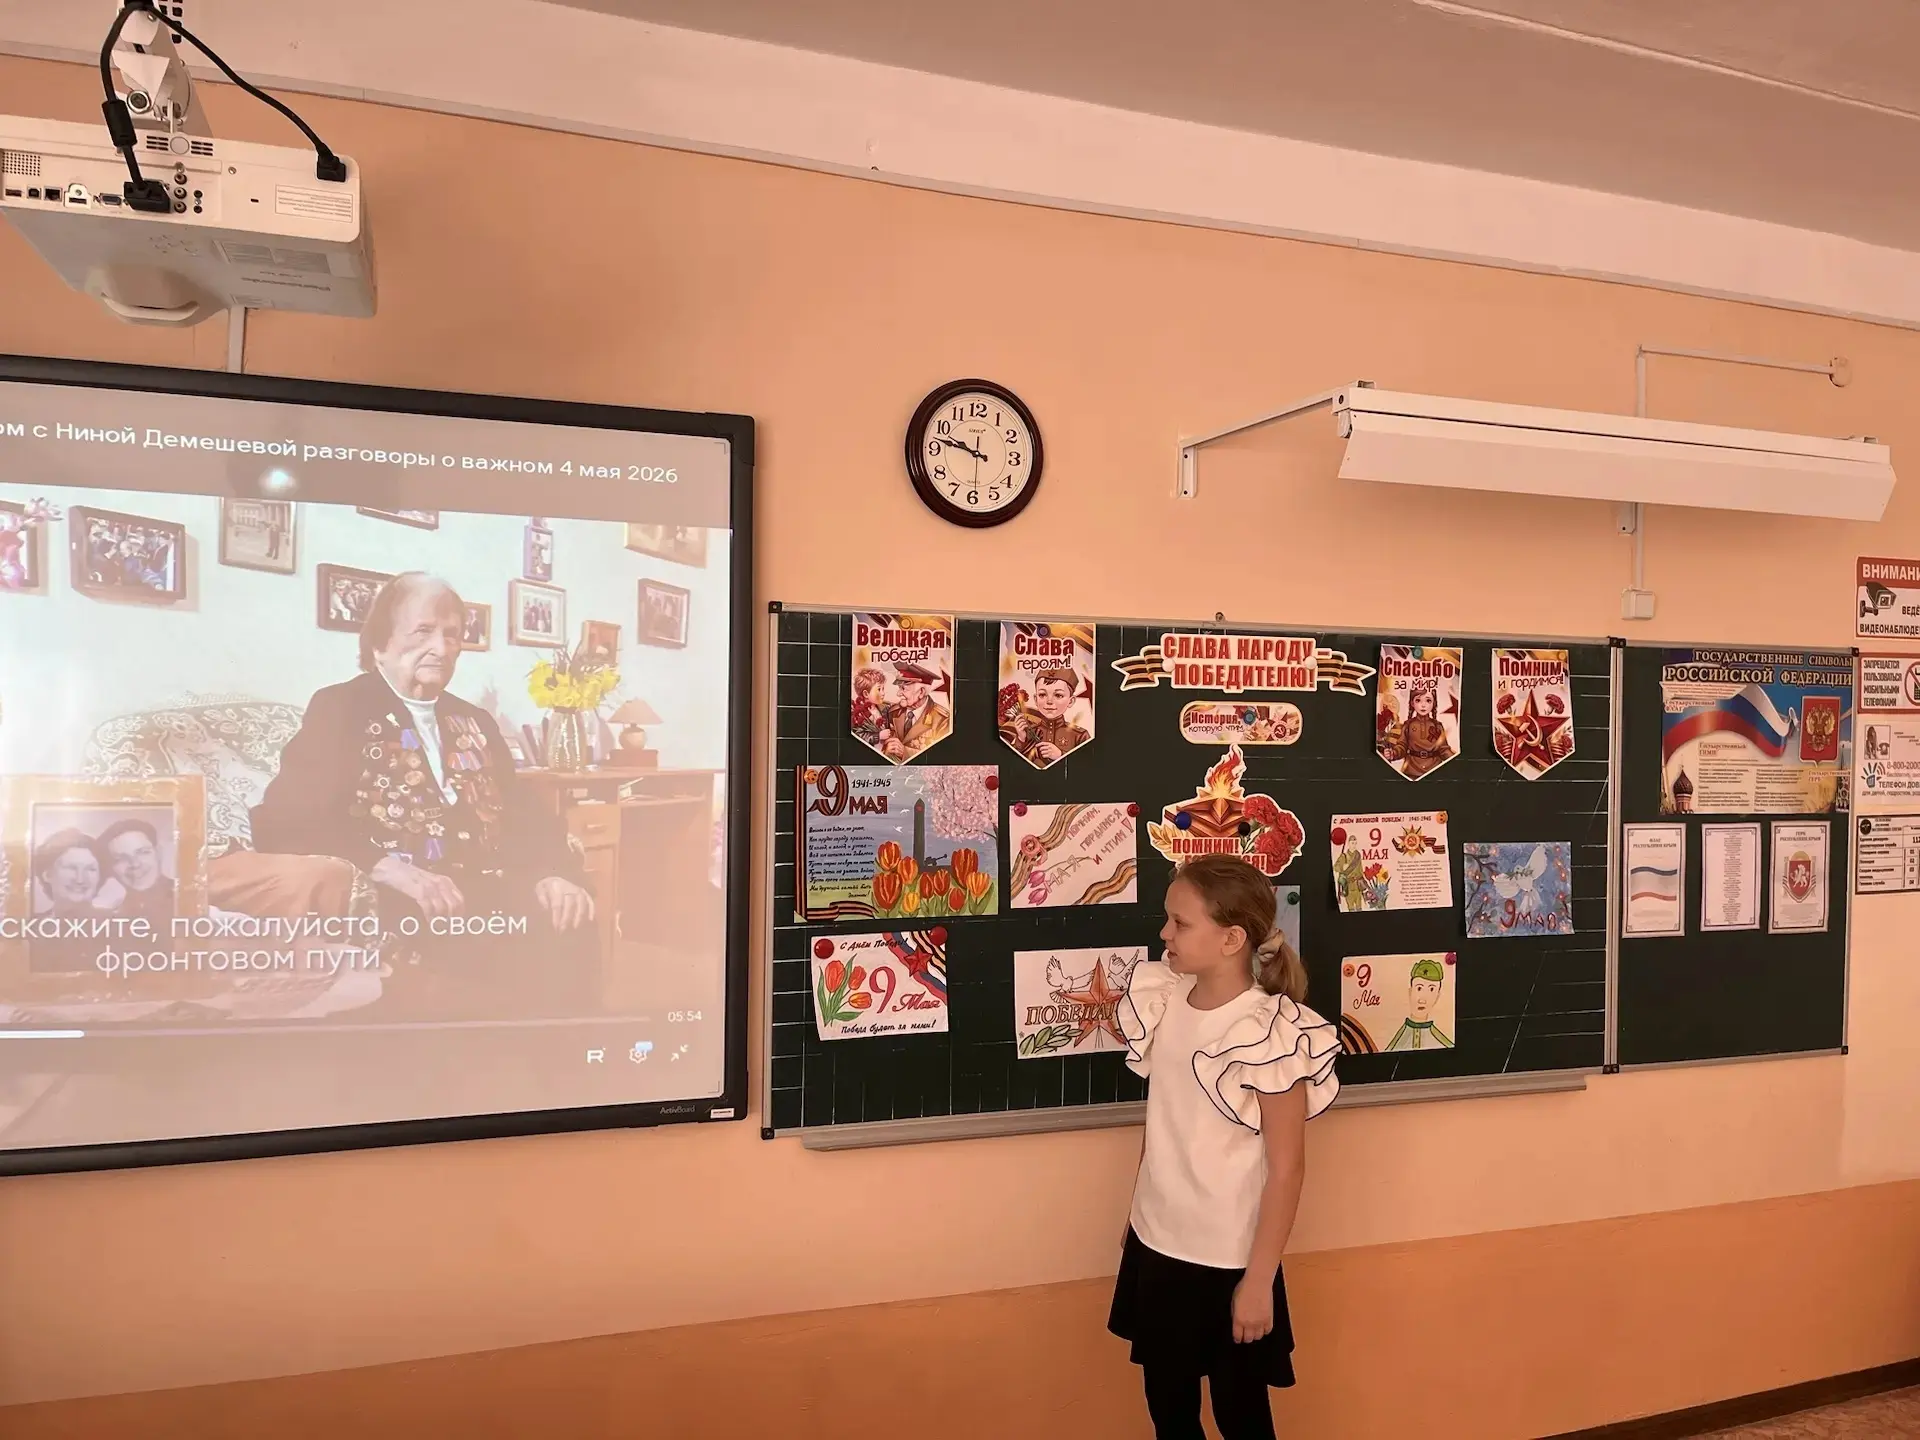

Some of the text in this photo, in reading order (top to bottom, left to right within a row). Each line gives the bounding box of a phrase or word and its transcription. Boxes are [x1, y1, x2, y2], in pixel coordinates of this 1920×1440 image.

[952, 406, 964, 421] 11
[969, 402, 988, 418] 12
[937, 420, 951, 435] 10
[995, 412, 1001, 427] 1
[1005, 429, 1017, 444] 2
[33, 425, 48, 438] с
[56, 421, 136, 445] Ниной
[143, 429, 297, 457] Демешевой
[303, 444, 435, 469] разговоры
[441, 455, 456, 468] о
[461, 456, 552, 474] важном
[559, 460, 574, 476] 4
[579, 464, 621, 480] мая
[628, 465, 679, 484] 2026
[928, 441, 941, 456] 9
[1008, 451, 1021, 466] 3
[934, 465, 946, 480] 8
[948, 482, 960, 496] 7
[1000, 474, 1013, 489] 4
[966, 490, 979, 505] 6
[988, 486, 1000, 501] 5
[857, 624, 945, 648] Великая
[1015, 633, 1074, 656] Слава
[1163, 636, 1232, 660] СЛАВА
[871, 647, 929, 663] победа!
[1694, 650, 1852, 667] ГОСУДАРСТВЕННЫЕ СИМВОЛЫ
[1017, 655, 1071, 674] героям!
[1384, 656, 1454, 679] Спасибо
[1499, 657, 1562, 676] Помним
[1863, 660, 1899, 669] ЗАПРЕЩАЕТСЯ
[1174, 663, 1316, 690] ПОБЕДИТЕЛЮ!
[1394, 677, 1439, 692] за мир!
[1498, 673, 1564, 691] и гордимся!
[1666, 666, 1852, 687] РОССИЙСКОЙ ФЕДЕРАЦИИ
[1863, 672, 1902, 682] ПОЛЬЗОВАТЬСЯ
[1863, 685, 1899, 694] МОБИЛЬНЫМИ
[1863, 697, 1897, 706] ТЕЛЕФОНАМИ
[1191, 711, 1242, 726] История,
[1188, 724, 1245, 734] которую чтим
[1699, 742, 1747, 750] Государственный
[807, 765, 891, 816] 9 1941-1945
[849, 795, 888, 815] МАЯ
[1066, 807, 1101, 841] ПОМНИМ,
[1080, 808, 1123, 852] ГОРДИМСЯ
[1369, 828, 1382, 847] 9
[1172, 838, 1240, 854] ПОМНИМ!
[1362, 848, 1389, 860] МАЯ
[1092, 854, 1103, 866] И
[1500, 899, 1516, 928] 9
[0, 911, 528, 944] скажите, пожалуйста, о своём
[840, 942, 847, 950] С
[847, 942, 871, 951] Днём
[96, 945, 381, 979] фронтовом пути
[1356, 963, 1371, 988] 9
[869, 966, 942, 1014] 9 Мая
[1353, 989, 1380, 1010] Мая
[667, 1010, 702, 1023] 05:54
[1025, 1001, 1115, 1025] ПОБЕДА!
[841, 1023, 866, 1034] Победа
[869, 1022, 895, 1034] будет
[910, 1020, 936, 1029] нами!
[660, 1105, 695, 1114] ActivBoard
